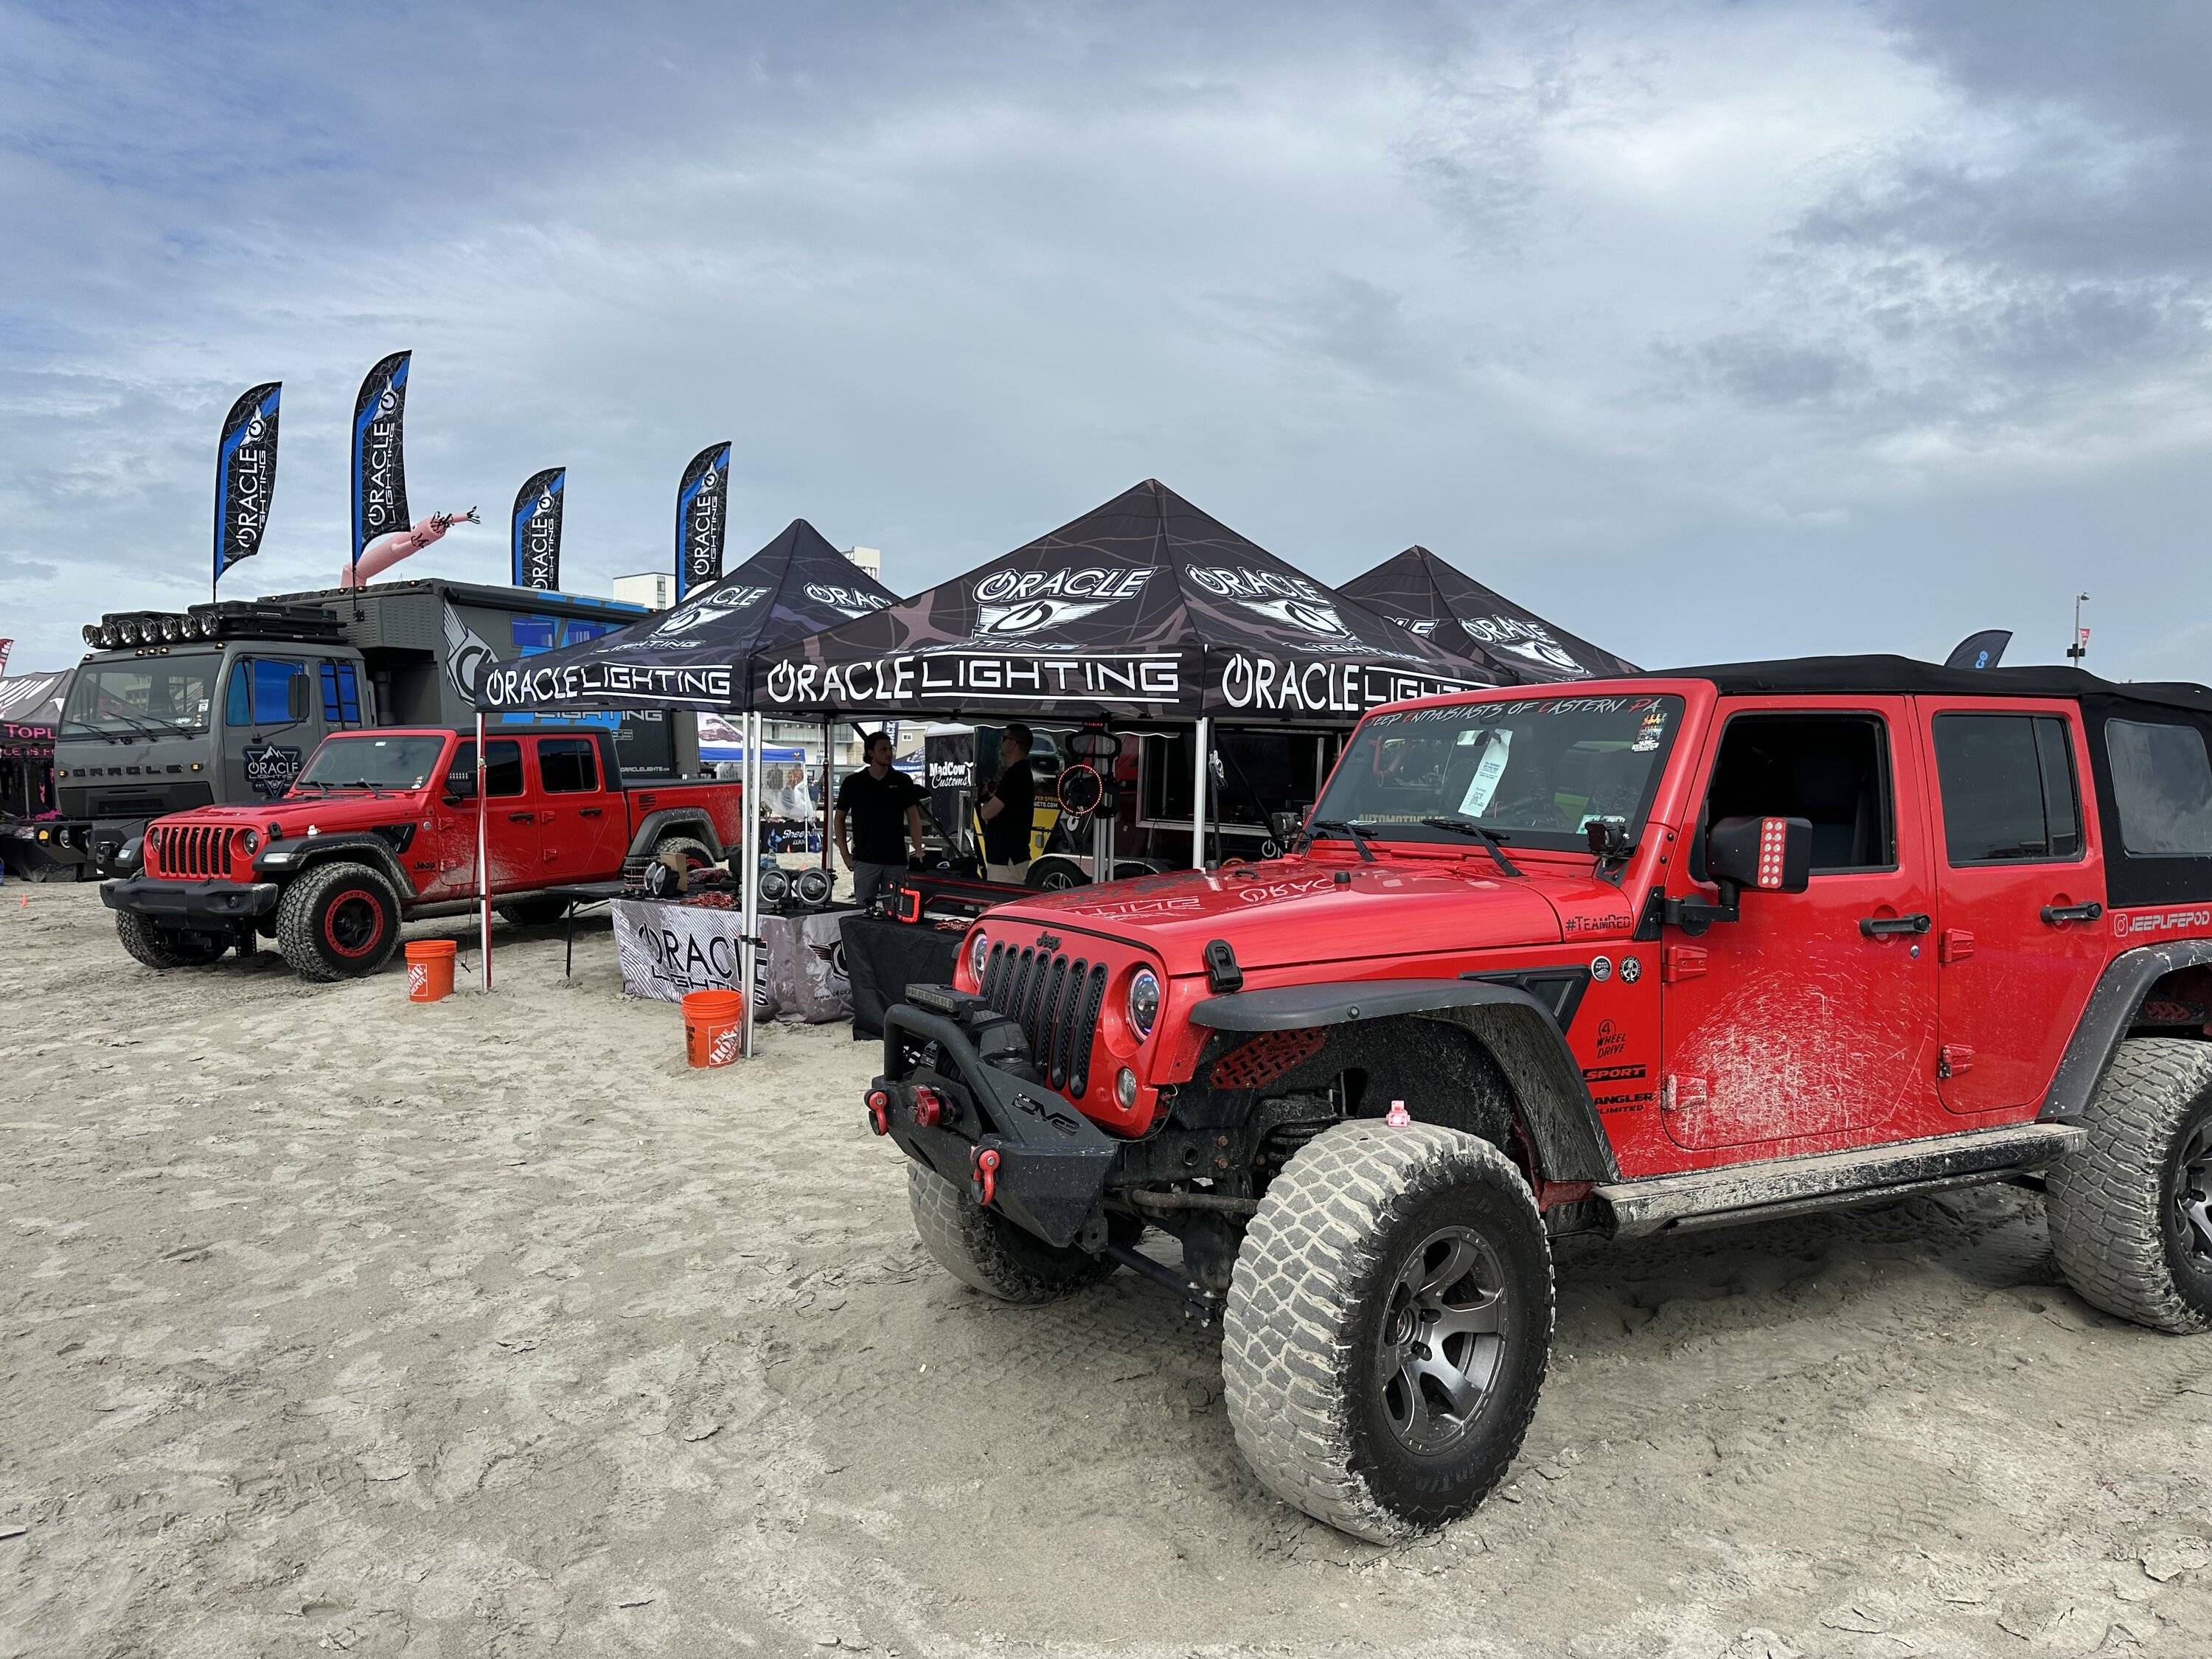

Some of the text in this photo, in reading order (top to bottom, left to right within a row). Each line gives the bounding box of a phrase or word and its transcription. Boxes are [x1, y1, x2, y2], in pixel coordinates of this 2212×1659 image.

[369, 422, 390, 526] ORACLE
[386, 422, 395, 524] LIGHTING
[236, 448, 258, 548] ORACLE
[693, 496, 711, 575] ORACLE
[710, 495, 718, 575] LIGHTING
[804, 582, 892, 610] ORAC
[973, 566, 1158, 602] ORACLE
[1186, 564, 1336, 606] ORACLE
[486, 666, 731, 705] ORACLE LIGHTING
[768, 656, 1180, 703] ORACLE LIGHTING
[1222, 653, 1467, 712] ORACLE LIGH
[1365, 713, 1402, 727] JEEP
[1402, 703, 1506, 725] ENTHUSIASTS
[1507, 701, 1540, 715] OF
[1628, 698, 1662, 714] PA
[930, 762, 967, 777] MadCow
[932, 774, 968, 789] Customs
[2129, 911, 2210, 931] JEEPLIFEPOD
[1037, 931, 1062, 953] Jeep
[652, 965, 770, 1006] LIGHT
[1596, 1033, 1627, 1047] WHEEL
[1597, 1043, 1626, 1060] DRIVE
[1587, 1068, 1641, 1079] SPORT
[1593, 1093, 1654, 1105] ANGLER
[1598, 1105, 1644, 1115] LIMITED
